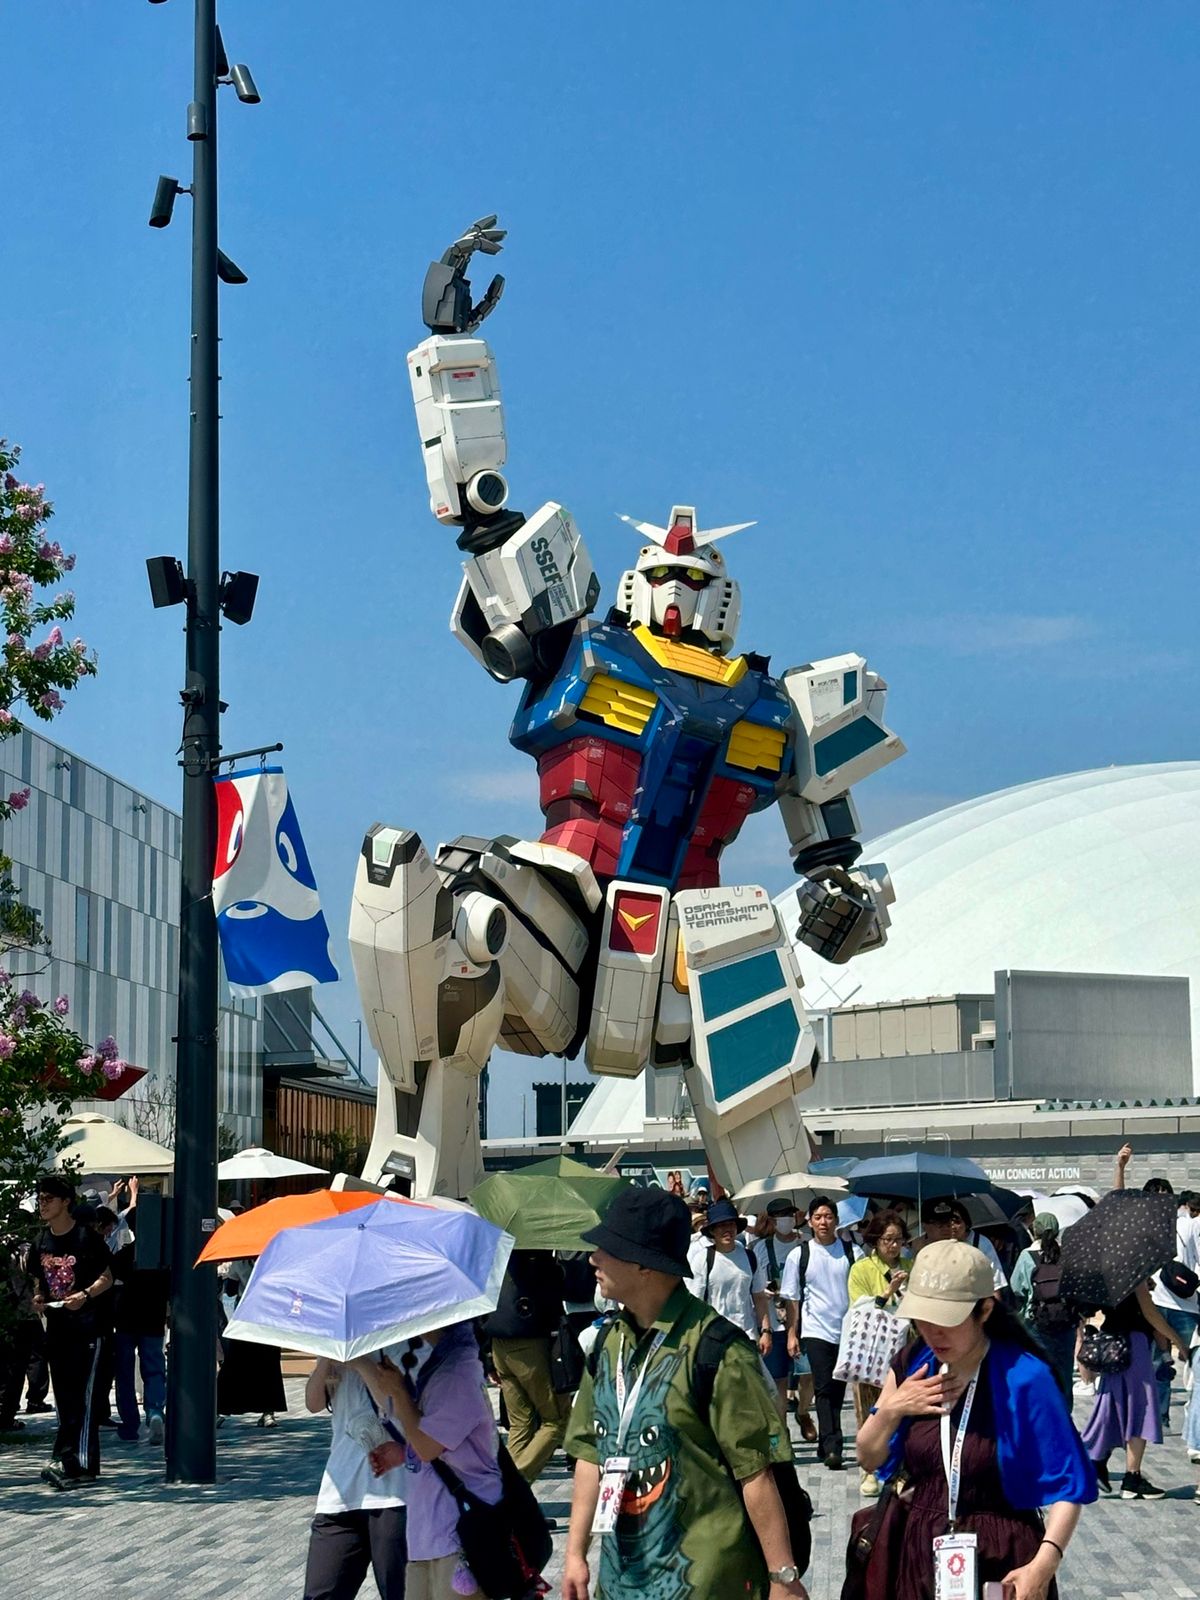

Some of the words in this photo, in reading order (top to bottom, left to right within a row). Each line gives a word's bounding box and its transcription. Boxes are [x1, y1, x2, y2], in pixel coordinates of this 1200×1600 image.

[531, 537, 563, 586] SSEF
[684, 901, 731, 914] OSAKA
[685, 903, 769, 922] YUMESHIMA
[687, 914, 758, 929] TERMINAL
[1007, 1168, 1046, 1179] CONNECT
[1048, 1167, 1080, 1179] ACTION
